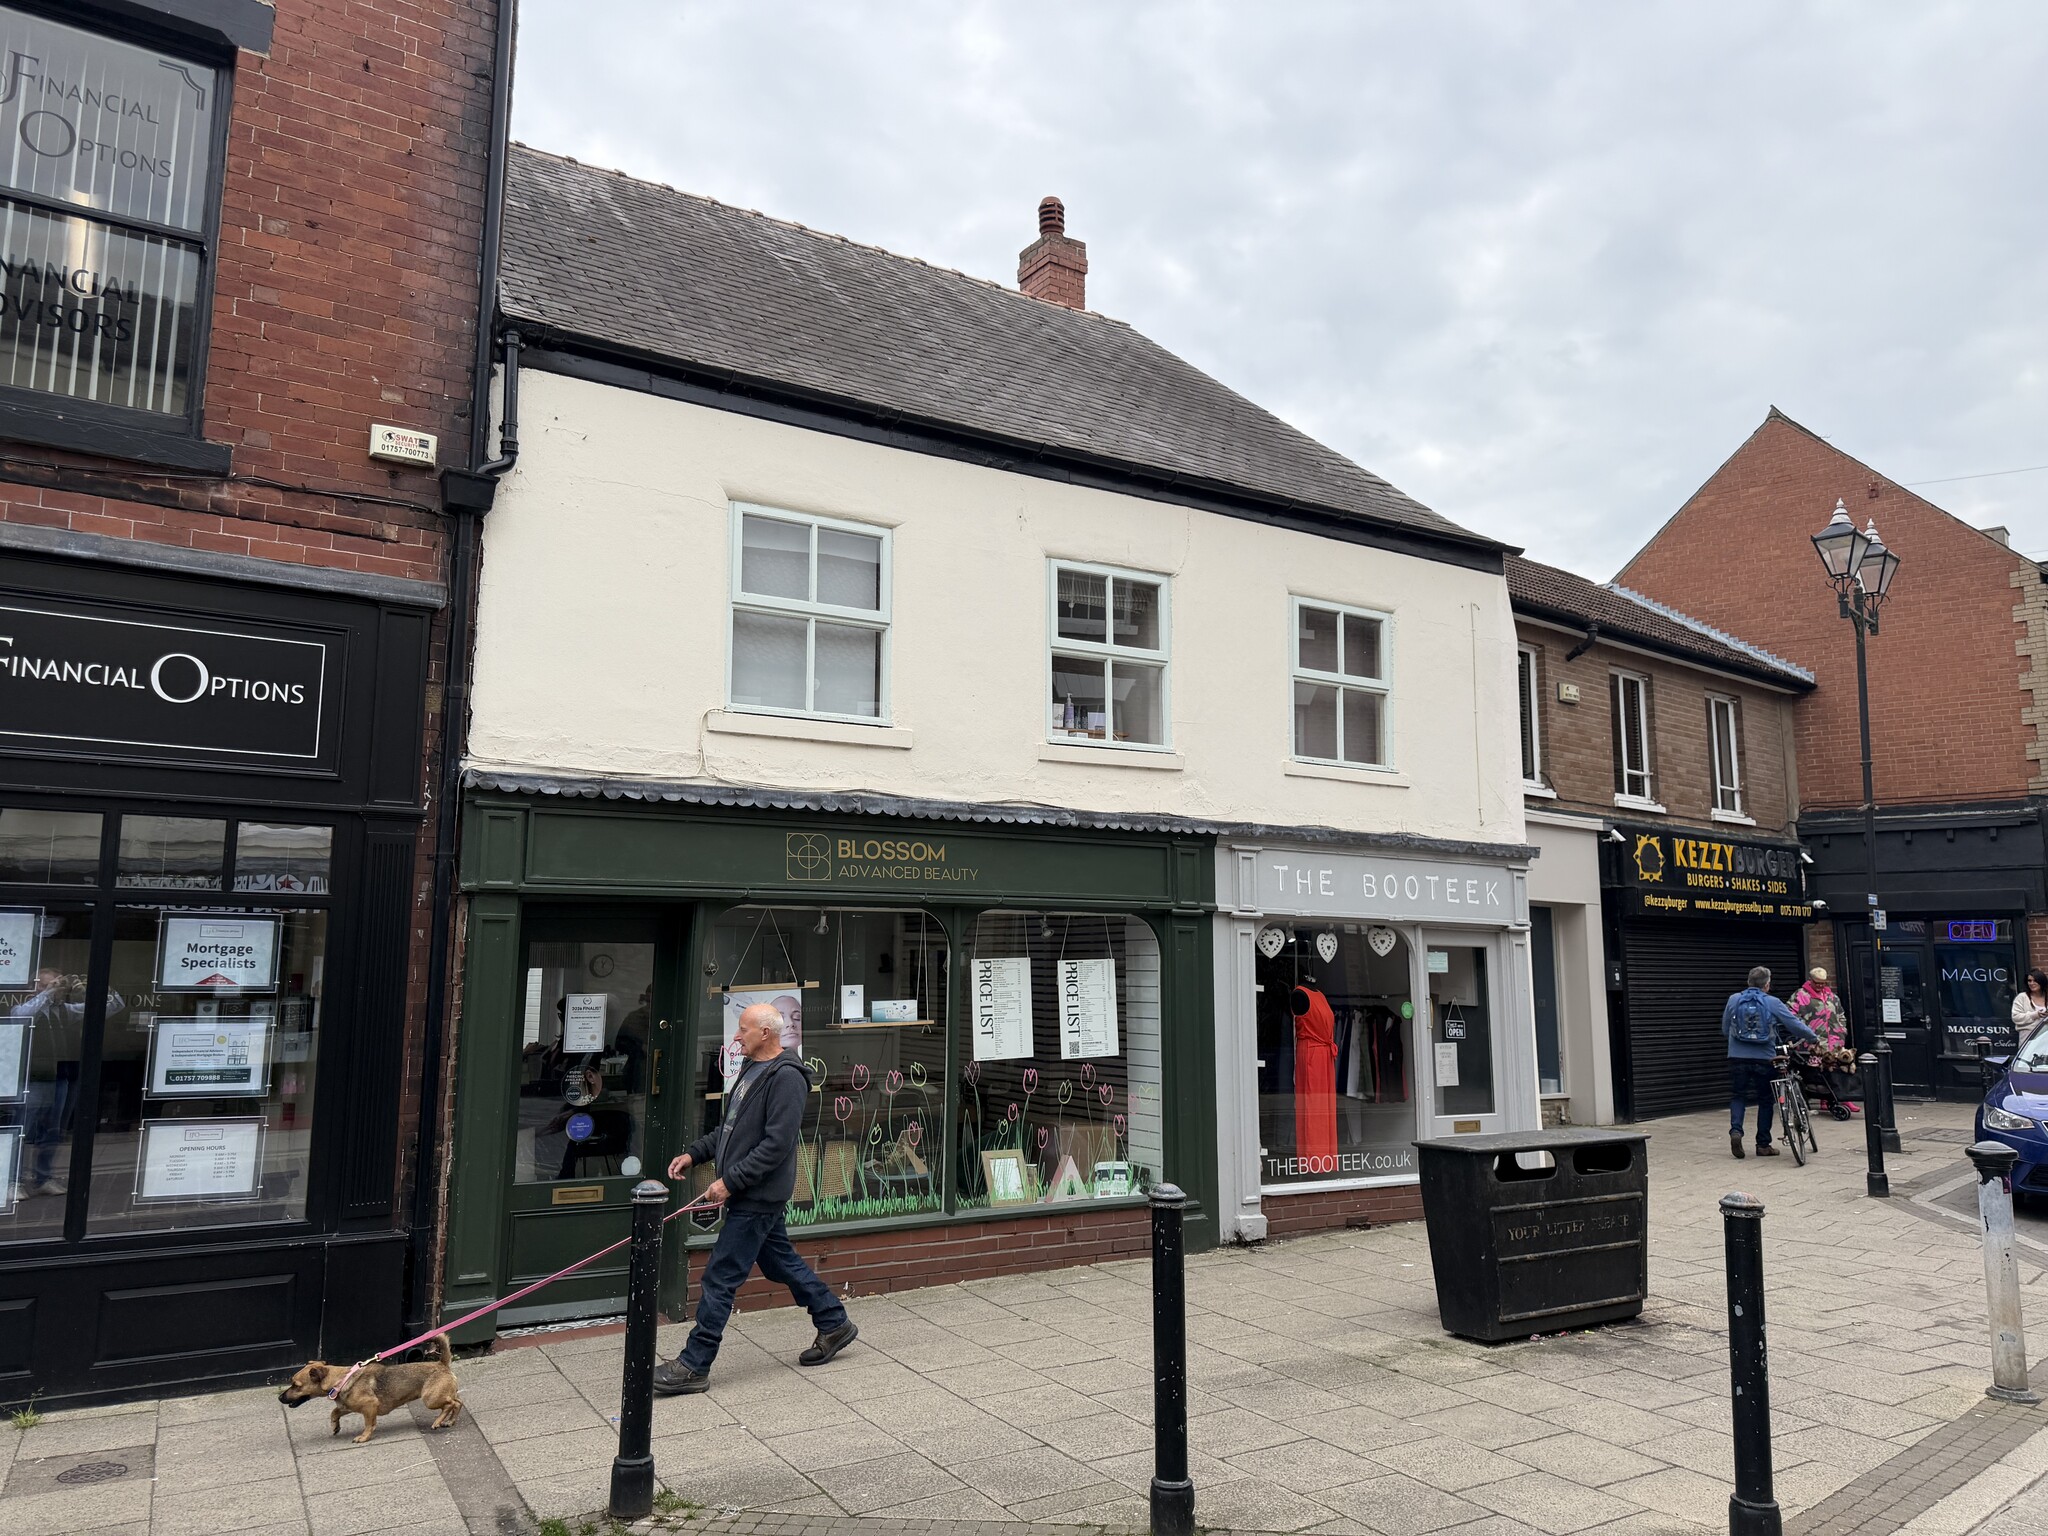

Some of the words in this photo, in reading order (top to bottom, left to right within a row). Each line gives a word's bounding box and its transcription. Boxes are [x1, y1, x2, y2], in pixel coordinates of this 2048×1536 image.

[0, 50, 159, 125] FINANCIAL
[20, 110, 172, 178] OPTIONS
[395, 434, 419, 445] SWAT
[395, 440, 418, 449] SECURITY
[381, 444, 429, 459] 01757-700773
[151, 653, 305, 705] OPTIONS
[837, 839, 946, 862] BLOSSOM
[838, 865, 921, 880] ADVANCED
[924, 867, 979, 881] BEAUTY
[1273, 865, 1335, 896] THE
[1362, 872, 1500, 906] BOOTEEK
[1687, 872, 1724, 889] BURGERS
[1731, 877, 1761, 892] SHAKES
[1767, 880, 1788, 894] SIDES
[1644, 894, 1688, 911] @kezzyburger
[1951, 924, 1993, 938] OPEN
[186, 943, 254, 957] Mortgage
[181, 957, 256, 970] Specialists
[979, 960, 993, 1003] PRICE
[1065, 961, 1079, 1003] PRICE
[1942, 968, 2008, 982] MAGIC
[980, 1005, 994, 1039] LIST
[1066, 1005, 1080, 1038] LIST
[1948, 1025, 1986, 1034] MAGIC
[1986, 1026, 2010, 1035] SUN
[1448, 1028, 1464, 1037] OPEN
[1267, 1150, 1412, 1177] THEBOOTEEK.co.uk
[1508, 1225, 1540, 1241] YOUR
